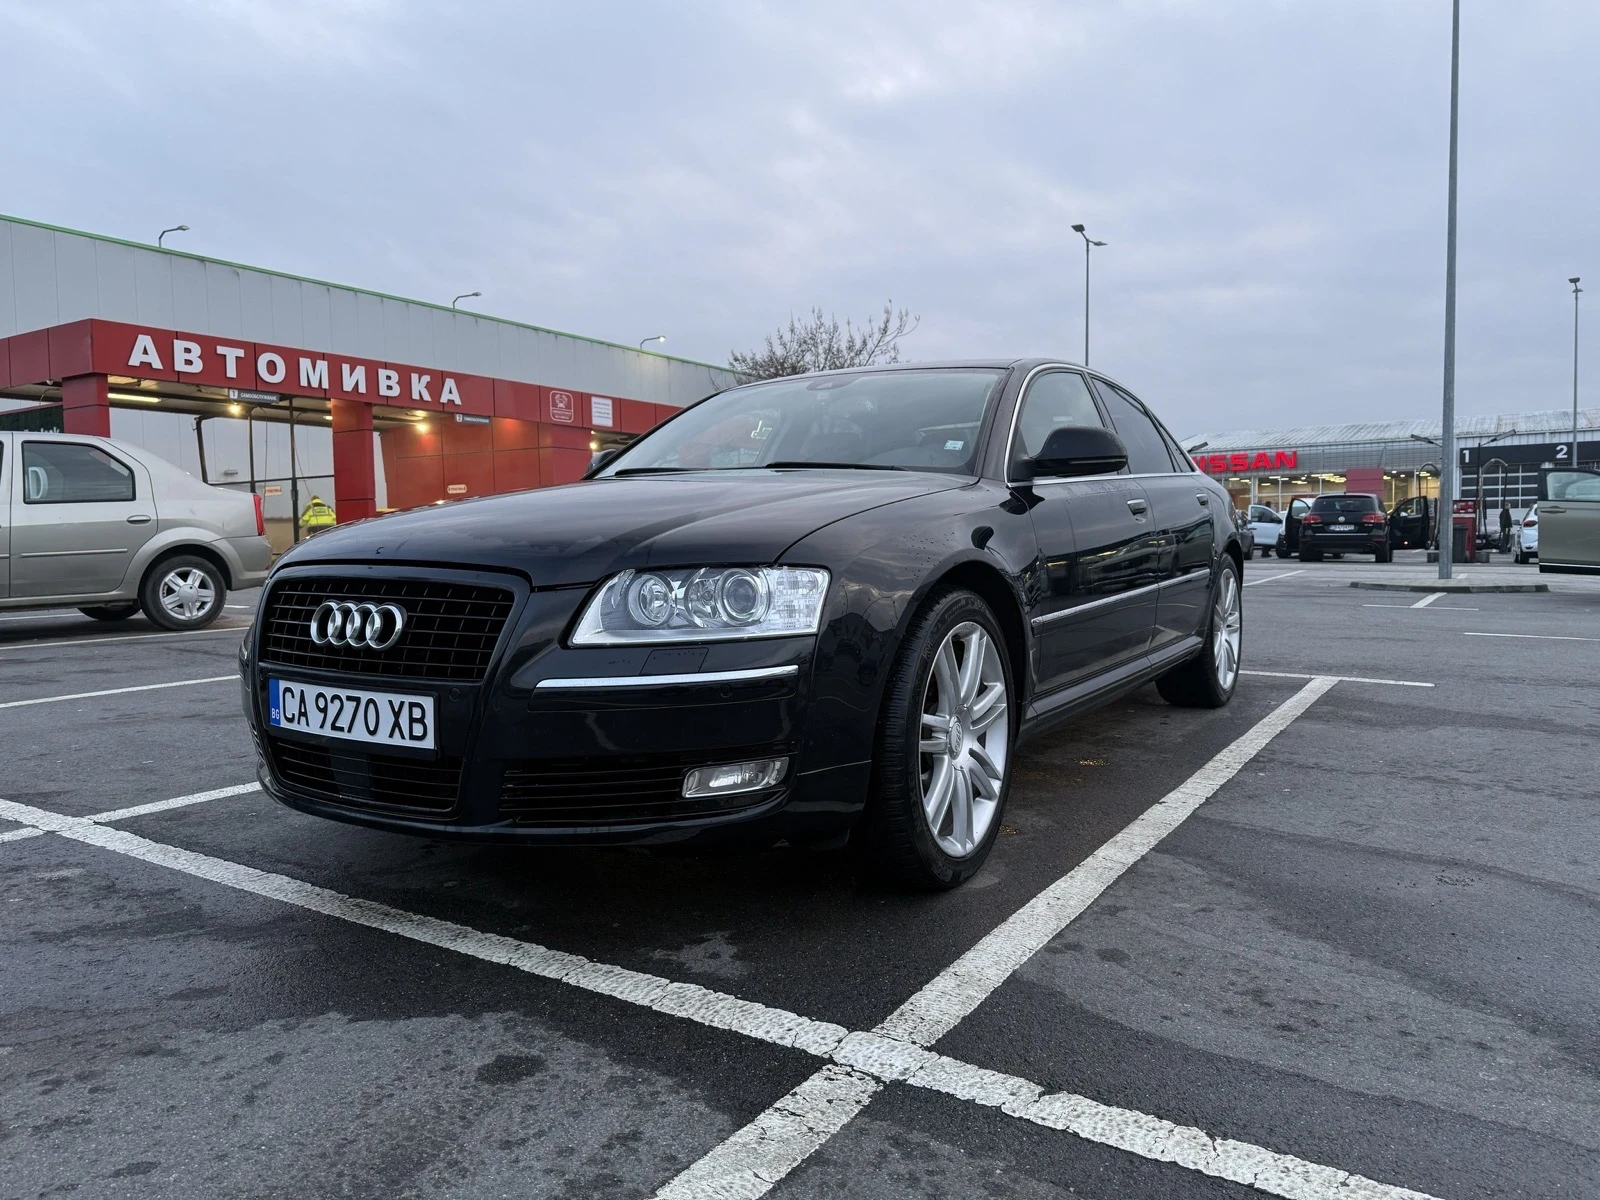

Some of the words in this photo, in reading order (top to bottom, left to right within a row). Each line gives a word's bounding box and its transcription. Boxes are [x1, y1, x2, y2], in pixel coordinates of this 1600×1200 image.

[128, 334, 462, 405] АВТОМИВКА
[1463, 449, 1470, 463] 1
[1556, 444, 1568, 459] 2
[271, 707, 280, 720] BG
[282, 686, 310, 727] CA
[314, 691, 380, 736] 9270
[388, 698, 428, 741] XB
